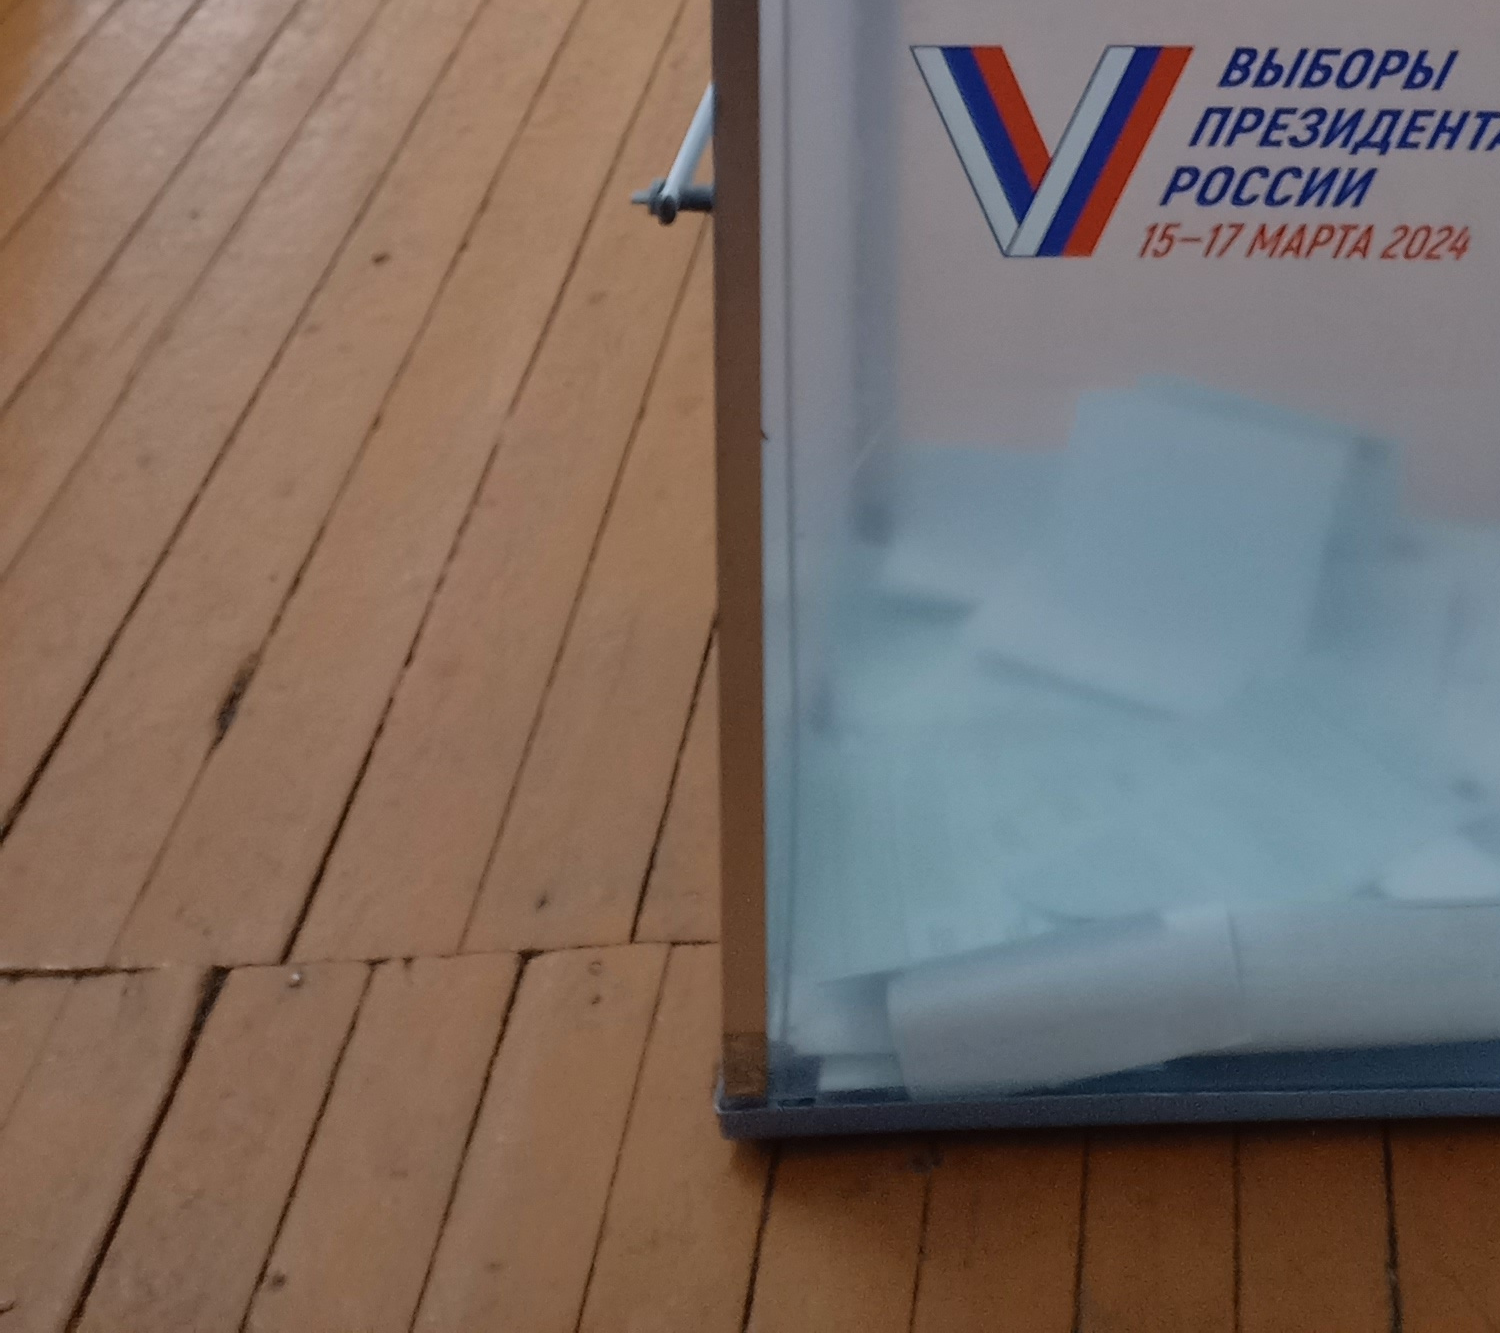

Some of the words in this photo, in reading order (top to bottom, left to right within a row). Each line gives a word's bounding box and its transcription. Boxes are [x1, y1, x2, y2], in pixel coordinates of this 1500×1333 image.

[1218, 46, 1459, 91] ВЫБОРЫ
[1160, 165, 1378, 208] РОССИИ
[1246, 223, 1375, 259] МАРТА
[1379, 224, 1471, 261] 2024
